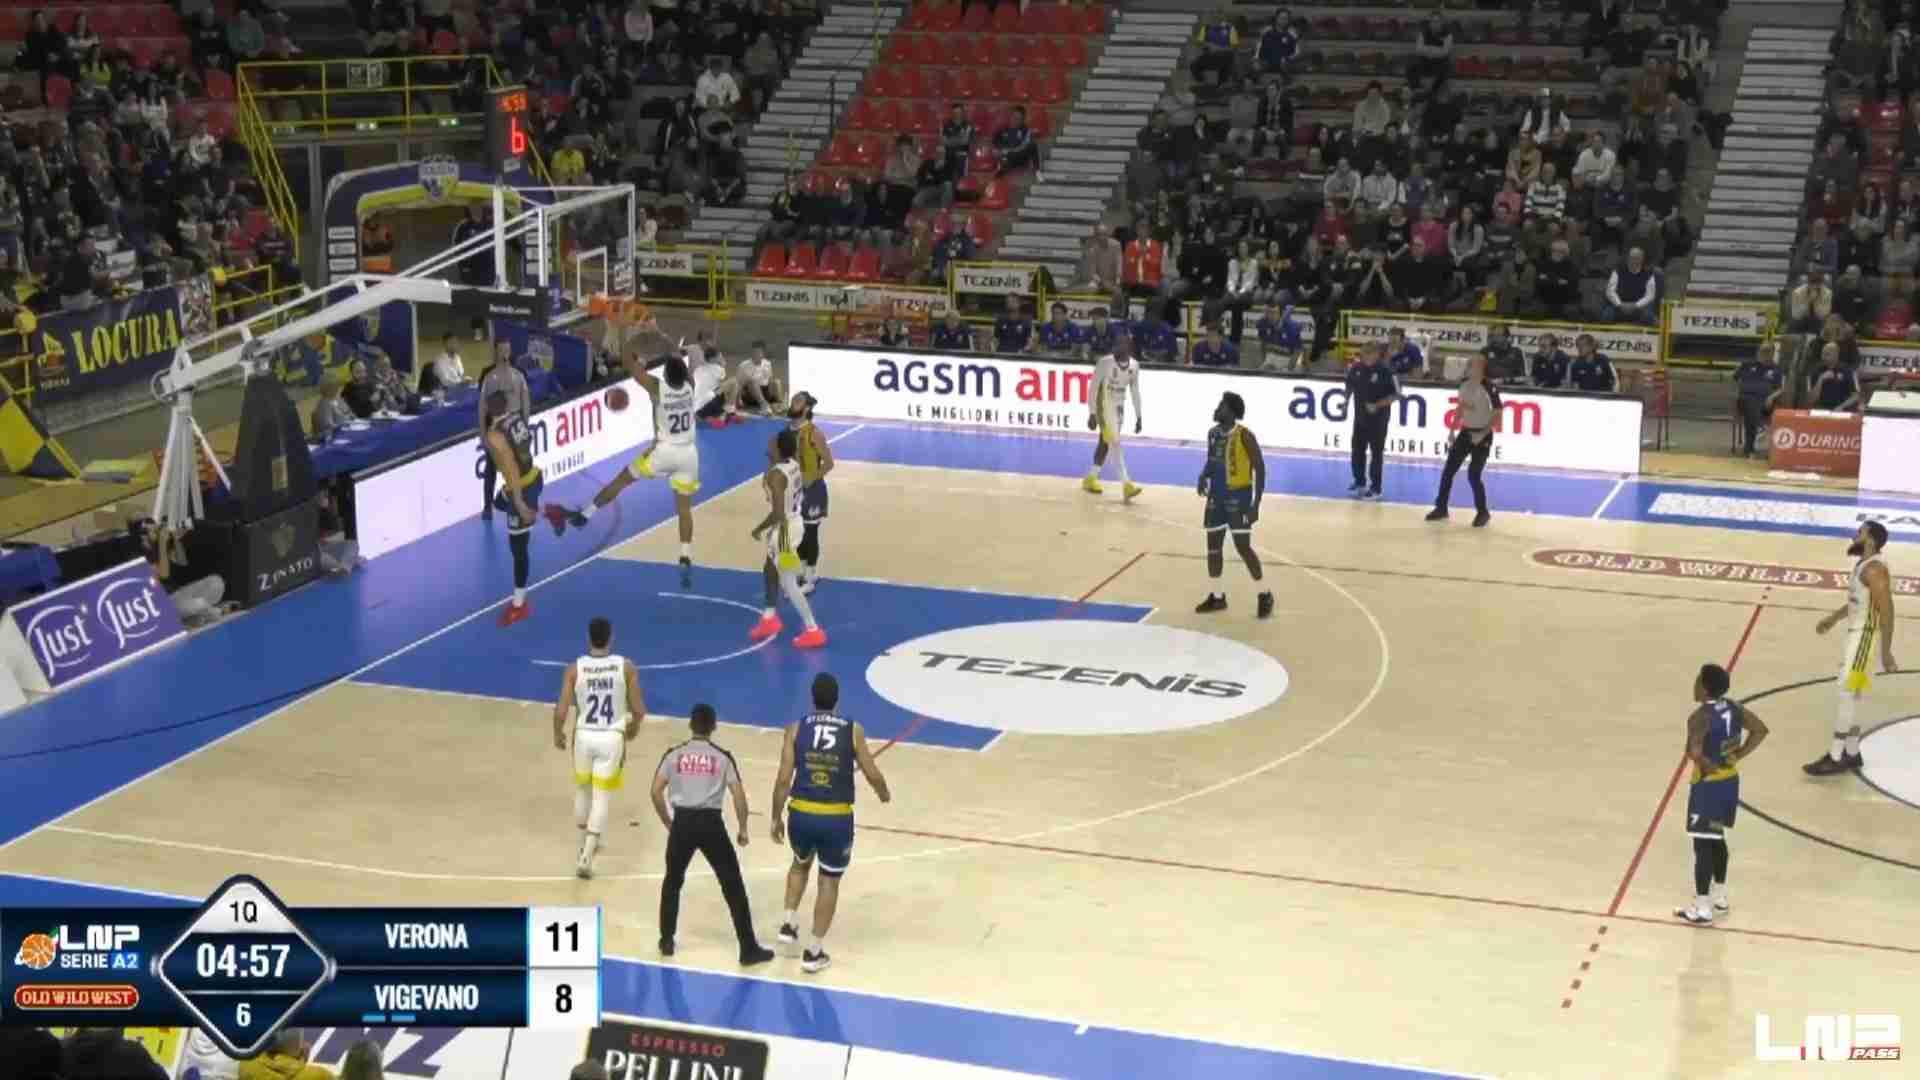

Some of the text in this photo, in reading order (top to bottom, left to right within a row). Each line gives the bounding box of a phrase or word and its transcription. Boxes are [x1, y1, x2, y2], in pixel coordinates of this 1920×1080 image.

[753, 289, 810, 304] TEZENIS
[1682, 315, 1750, 330] TEZENIS
[72, 309, 178, 375] LOCURA
[668, 411, 691, 435] 20
[907, 404, 1070, 428] LE MIGLIORI ENERGIE
[33, 587, 161, 678] Just Just
[585, 693, 615, 726] 24
[813, 724, 838, 750] 15
[629, 1031, 726, 1057] ESPRESSO
